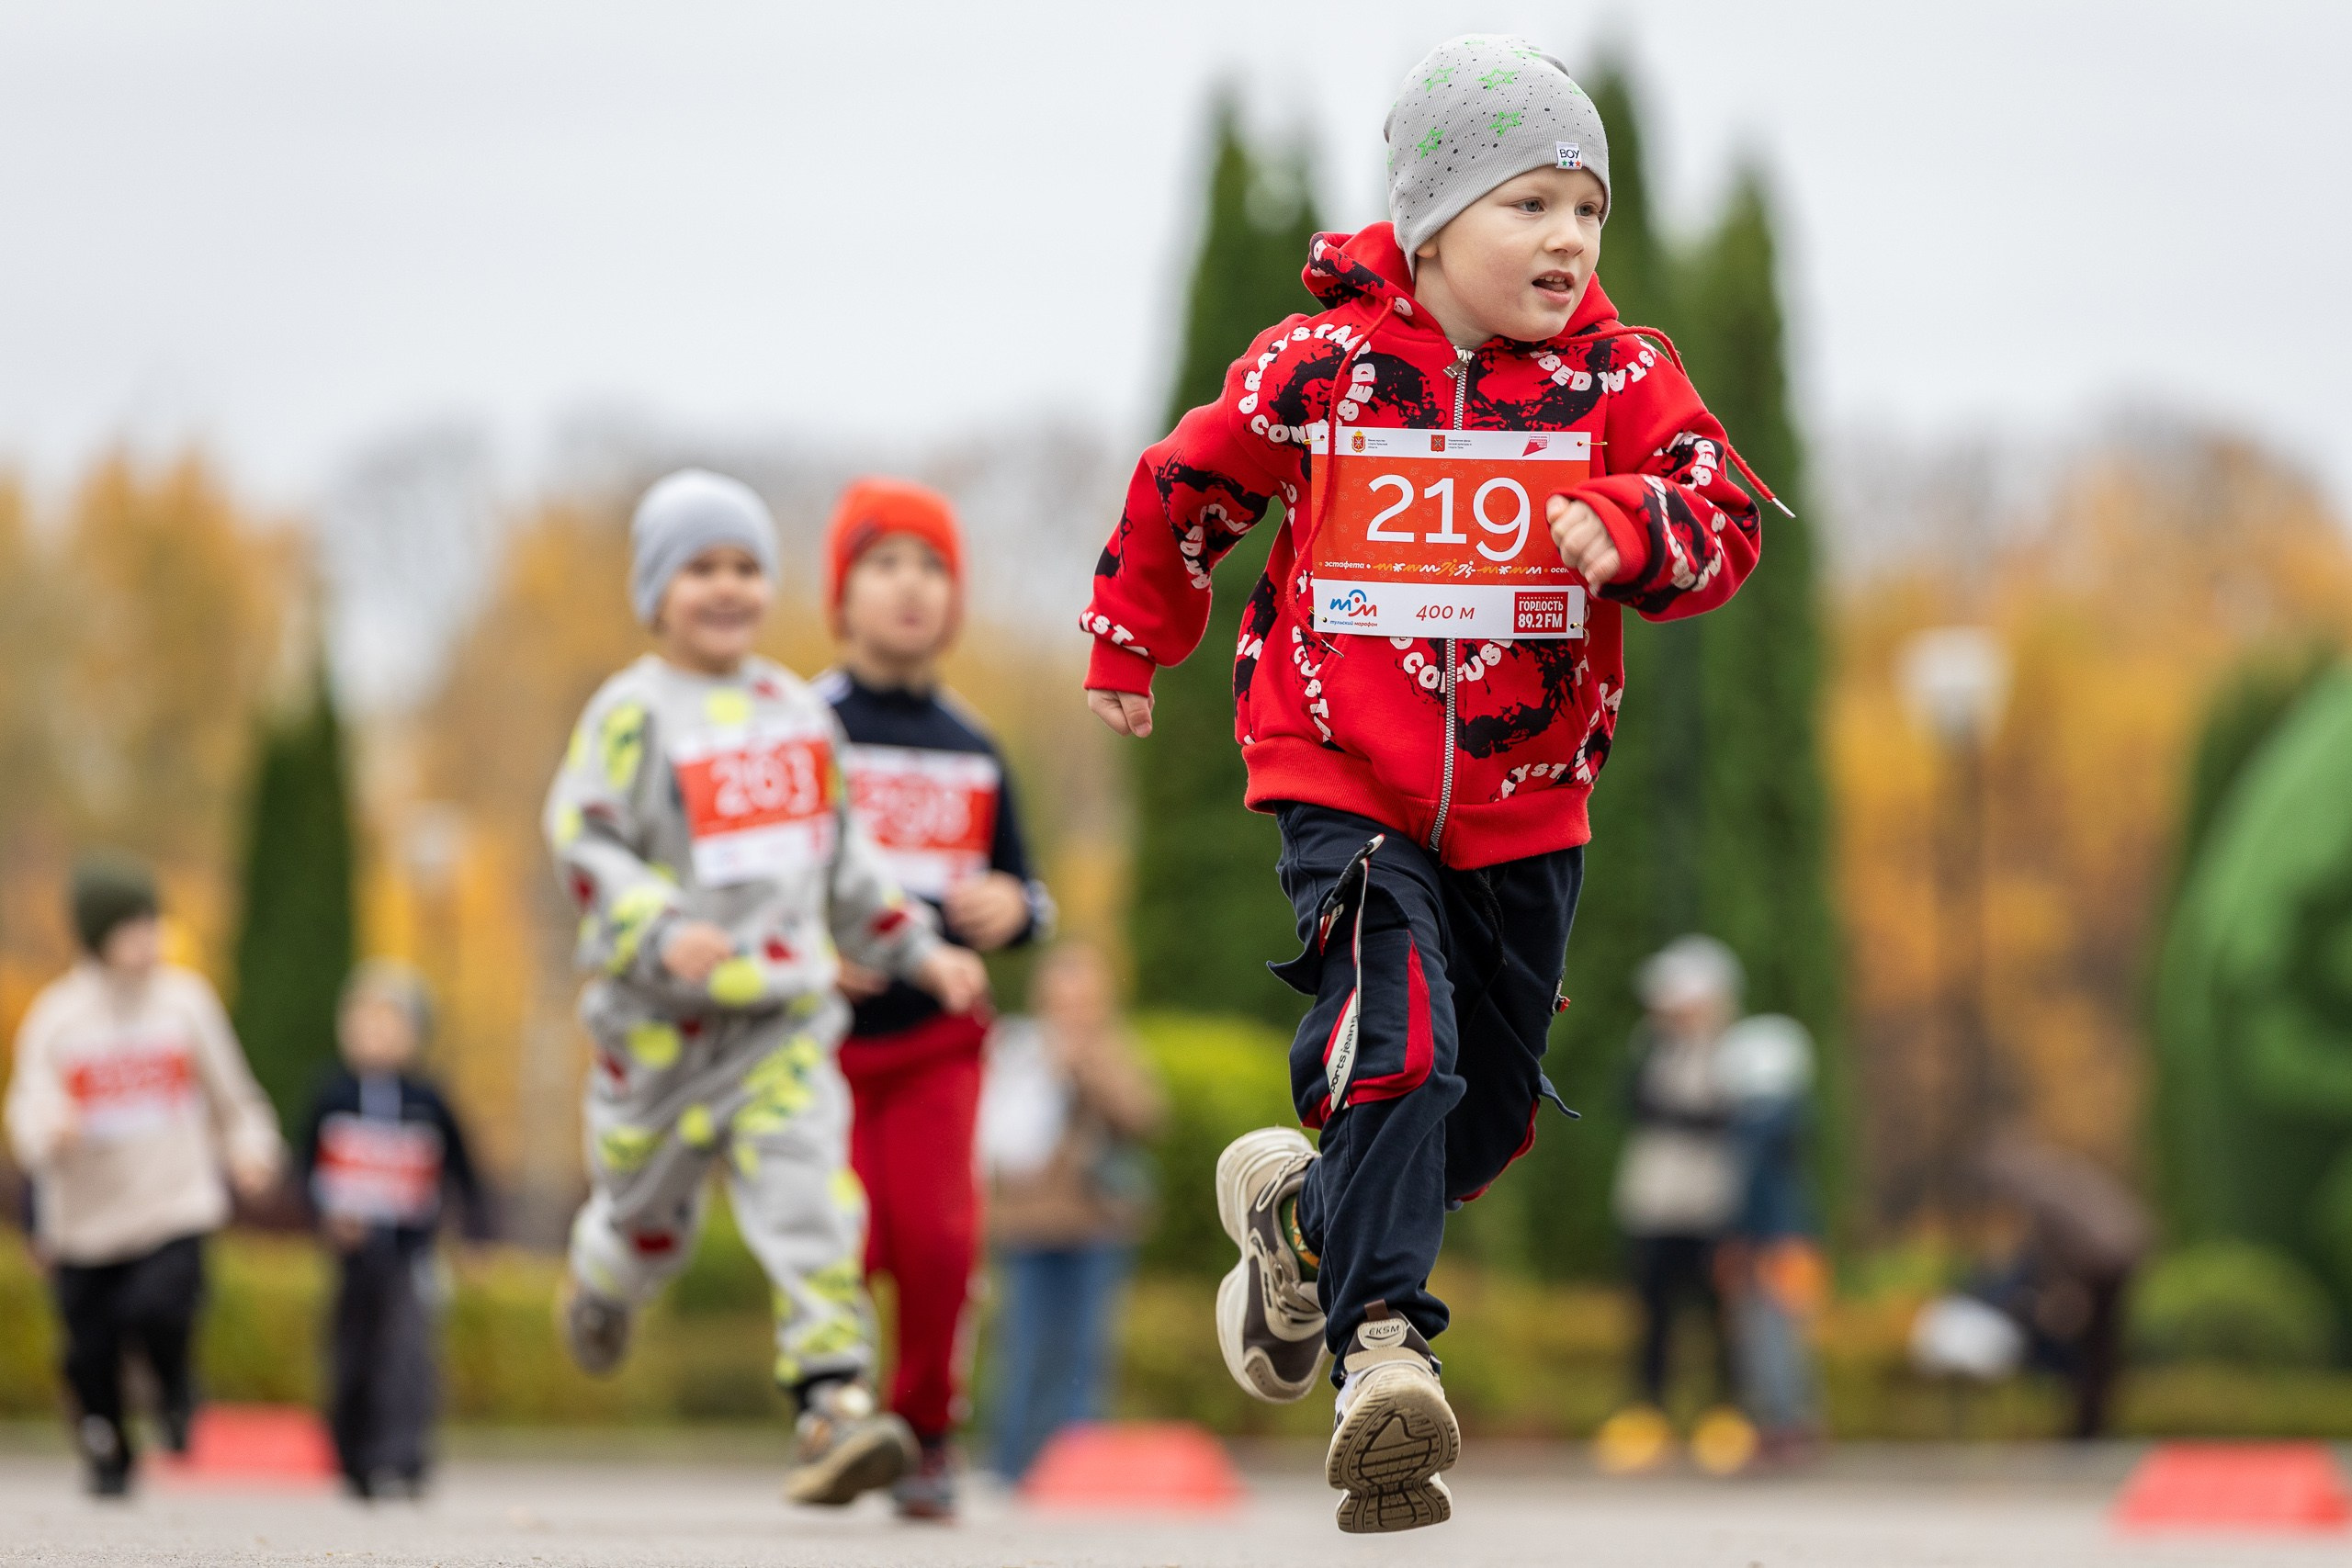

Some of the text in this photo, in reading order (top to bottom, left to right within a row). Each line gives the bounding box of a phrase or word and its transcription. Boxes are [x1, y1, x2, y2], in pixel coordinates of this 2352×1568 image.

[1559, 149, 1579, 159] BOY
[1366, 474, 1531, 562] 219
[1324, 560, 1365, 570] эстафета
[1519, 601, 1564, 612] ГОРДОСТЬ
[1416, 604, 1453, 621] 400
[1518, 613, 1563, 628] 89.2 FM
[1369, 1325, 1399, 1336] EKSM
